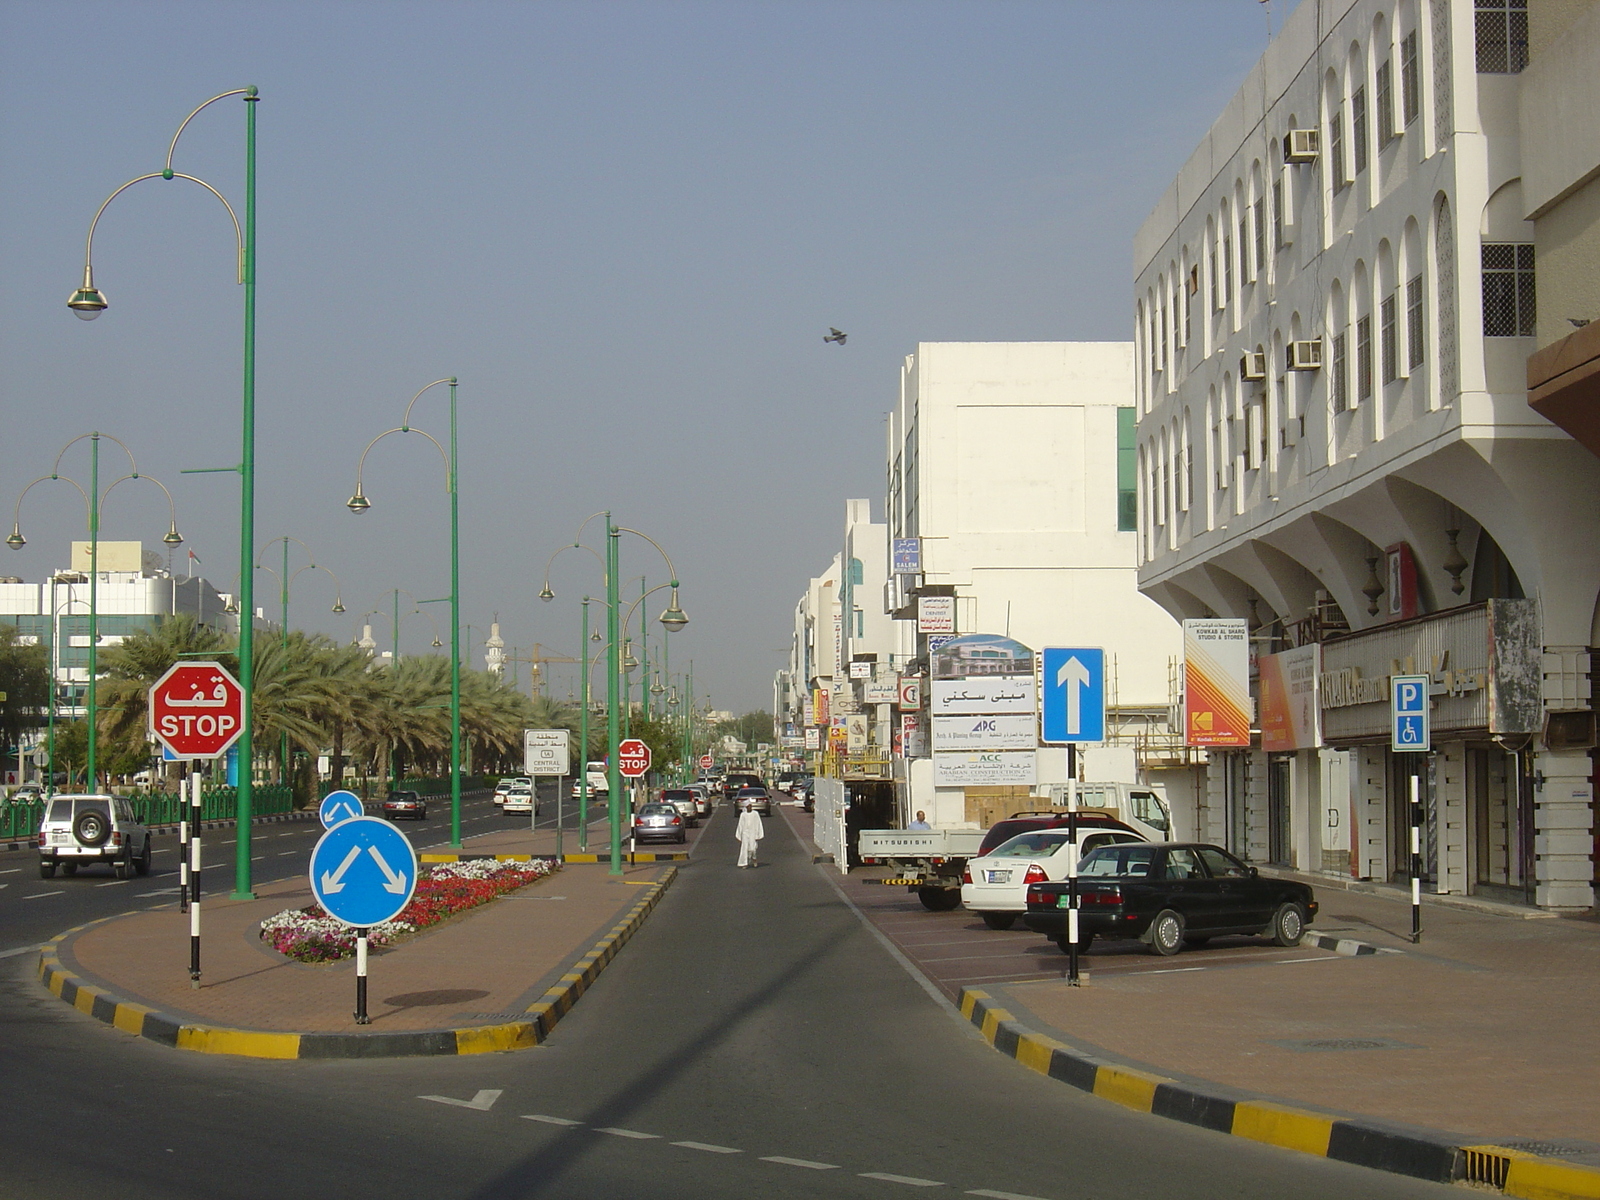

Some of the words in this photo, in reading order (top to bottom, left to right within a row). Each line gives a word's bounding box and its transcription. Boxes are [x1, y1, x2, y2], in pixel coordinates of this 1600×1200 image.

[164, 676, 228, 708] قف
[991, 690, 1026, 703] مبنى
[1402, 684, 1417, 710] P
[942, 690, 986, 708] سكني
[160, 714, 236, 737] STOP
[620, 744, 645, 757] قف
[619, 759, 648, 769] STOP
[979, 754, 1002, 762] ACC
[939, 763, 966, 771] العربية
[1009, 762, 1032, 770] شركة
